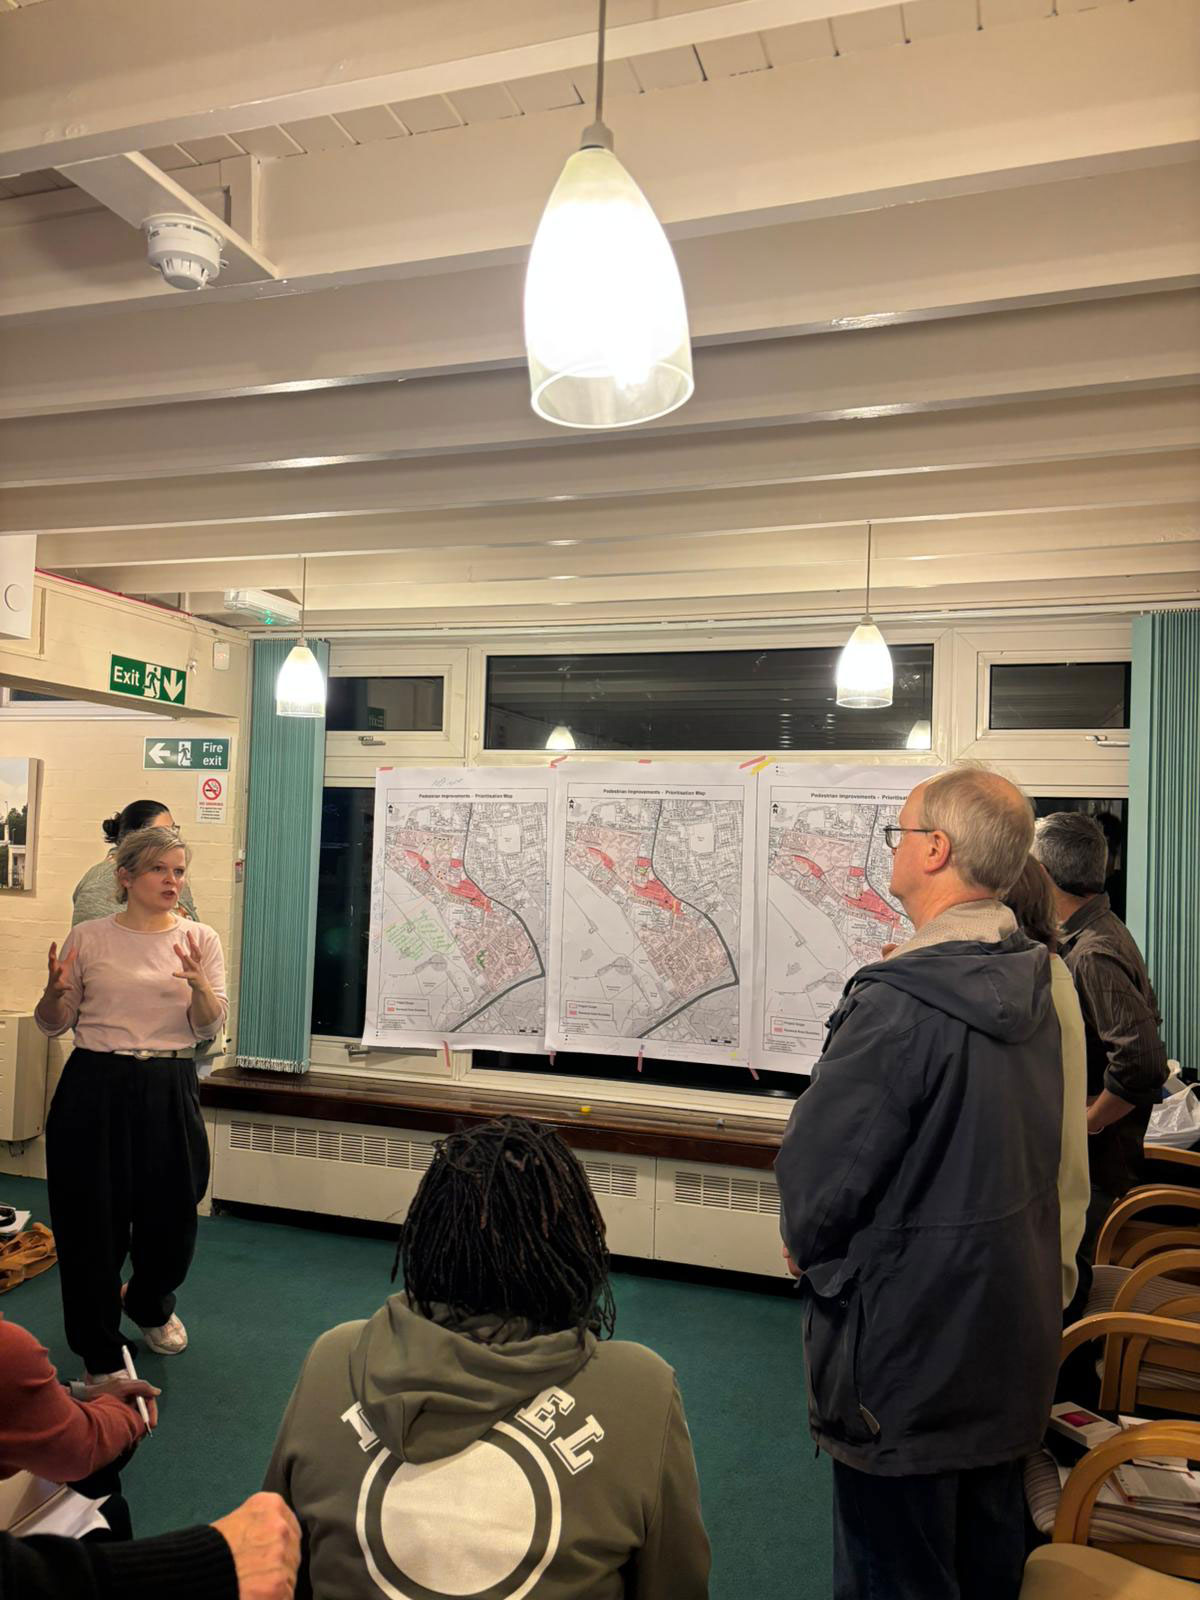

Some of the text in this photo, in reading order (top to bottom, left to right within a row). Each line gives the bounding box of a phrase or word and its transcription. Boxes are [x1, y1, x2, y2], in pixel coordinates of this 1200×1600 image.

[113, 665, 140, 687] Exit
[203, 742, 223, 753] Fire
[203, 755, 222, 766] exit
